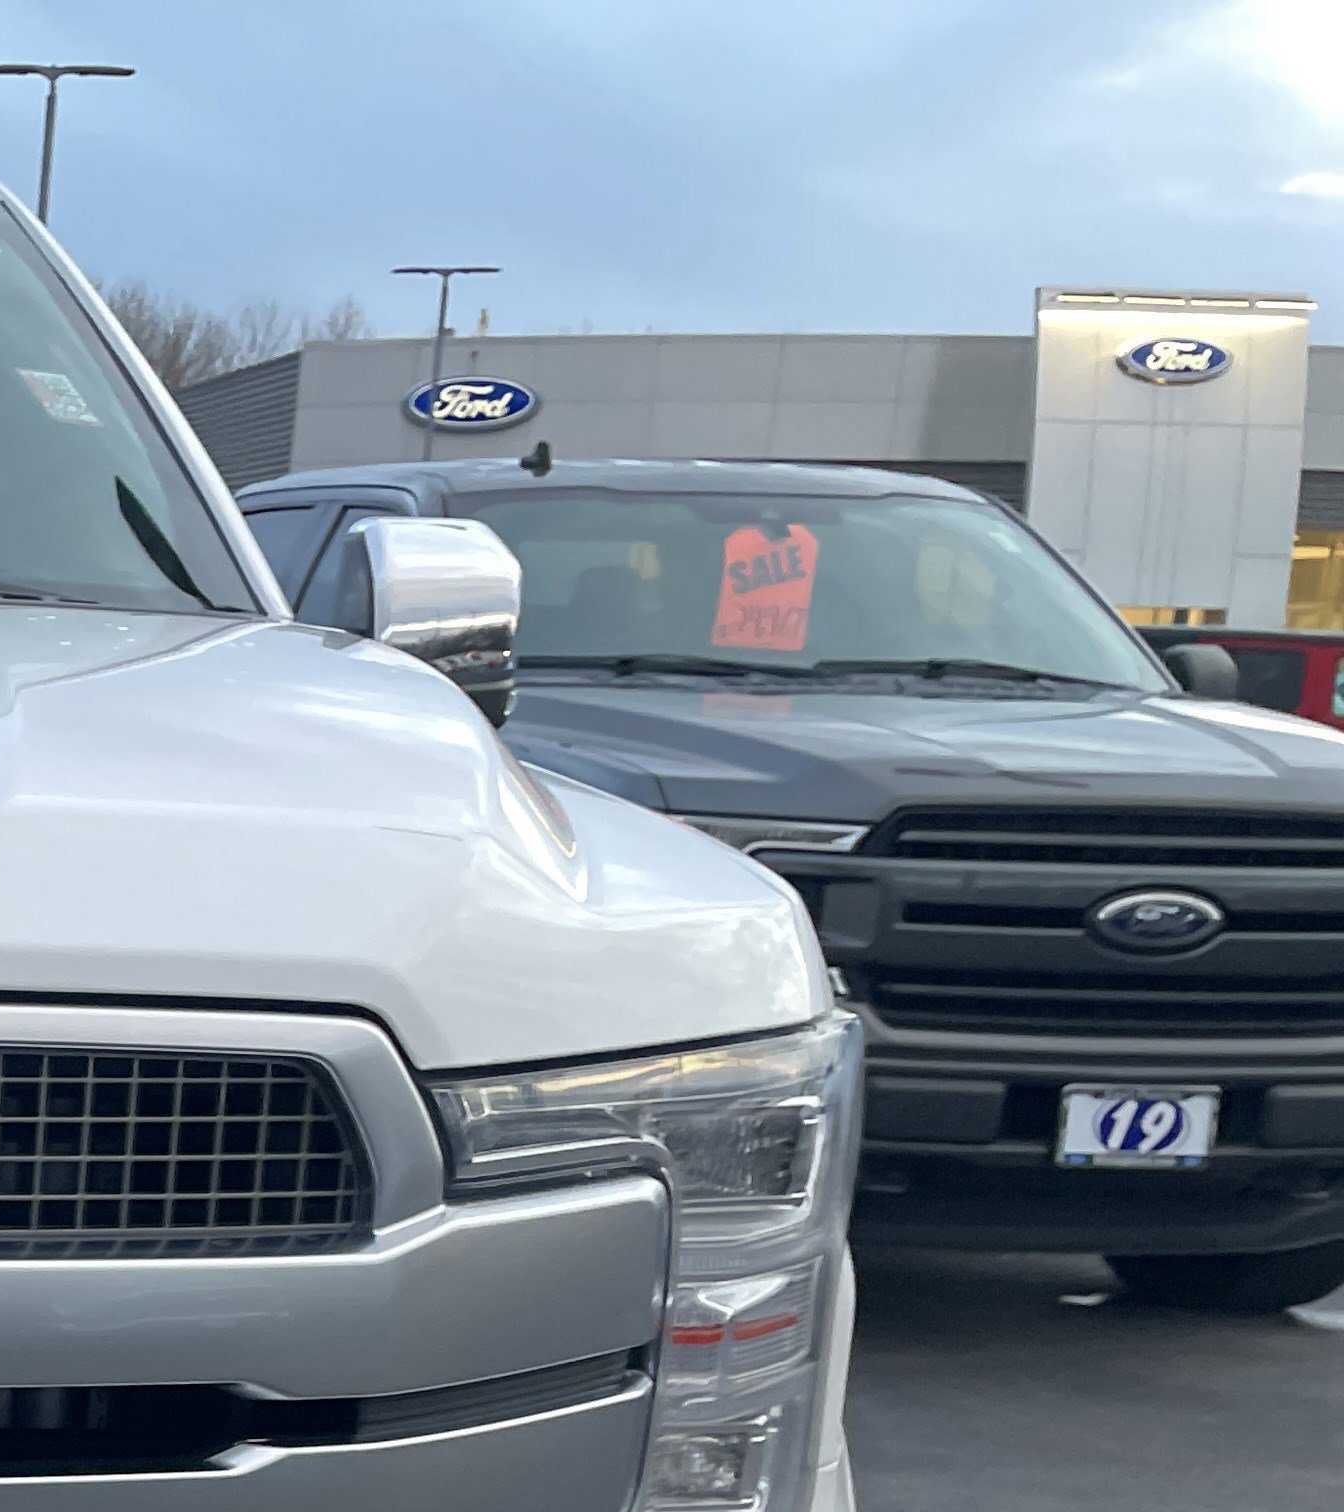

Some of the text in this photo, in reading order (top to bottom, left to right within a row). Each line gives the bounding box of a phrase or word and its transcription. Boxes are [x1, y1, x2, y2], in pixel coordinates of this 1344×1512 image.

[1146, 341, 1213, 371] Ford
[431, 384, 514, 419] Ford
[728, 544, 806, 595] SALE
[1106, 1098, 1178, 1154] 19
